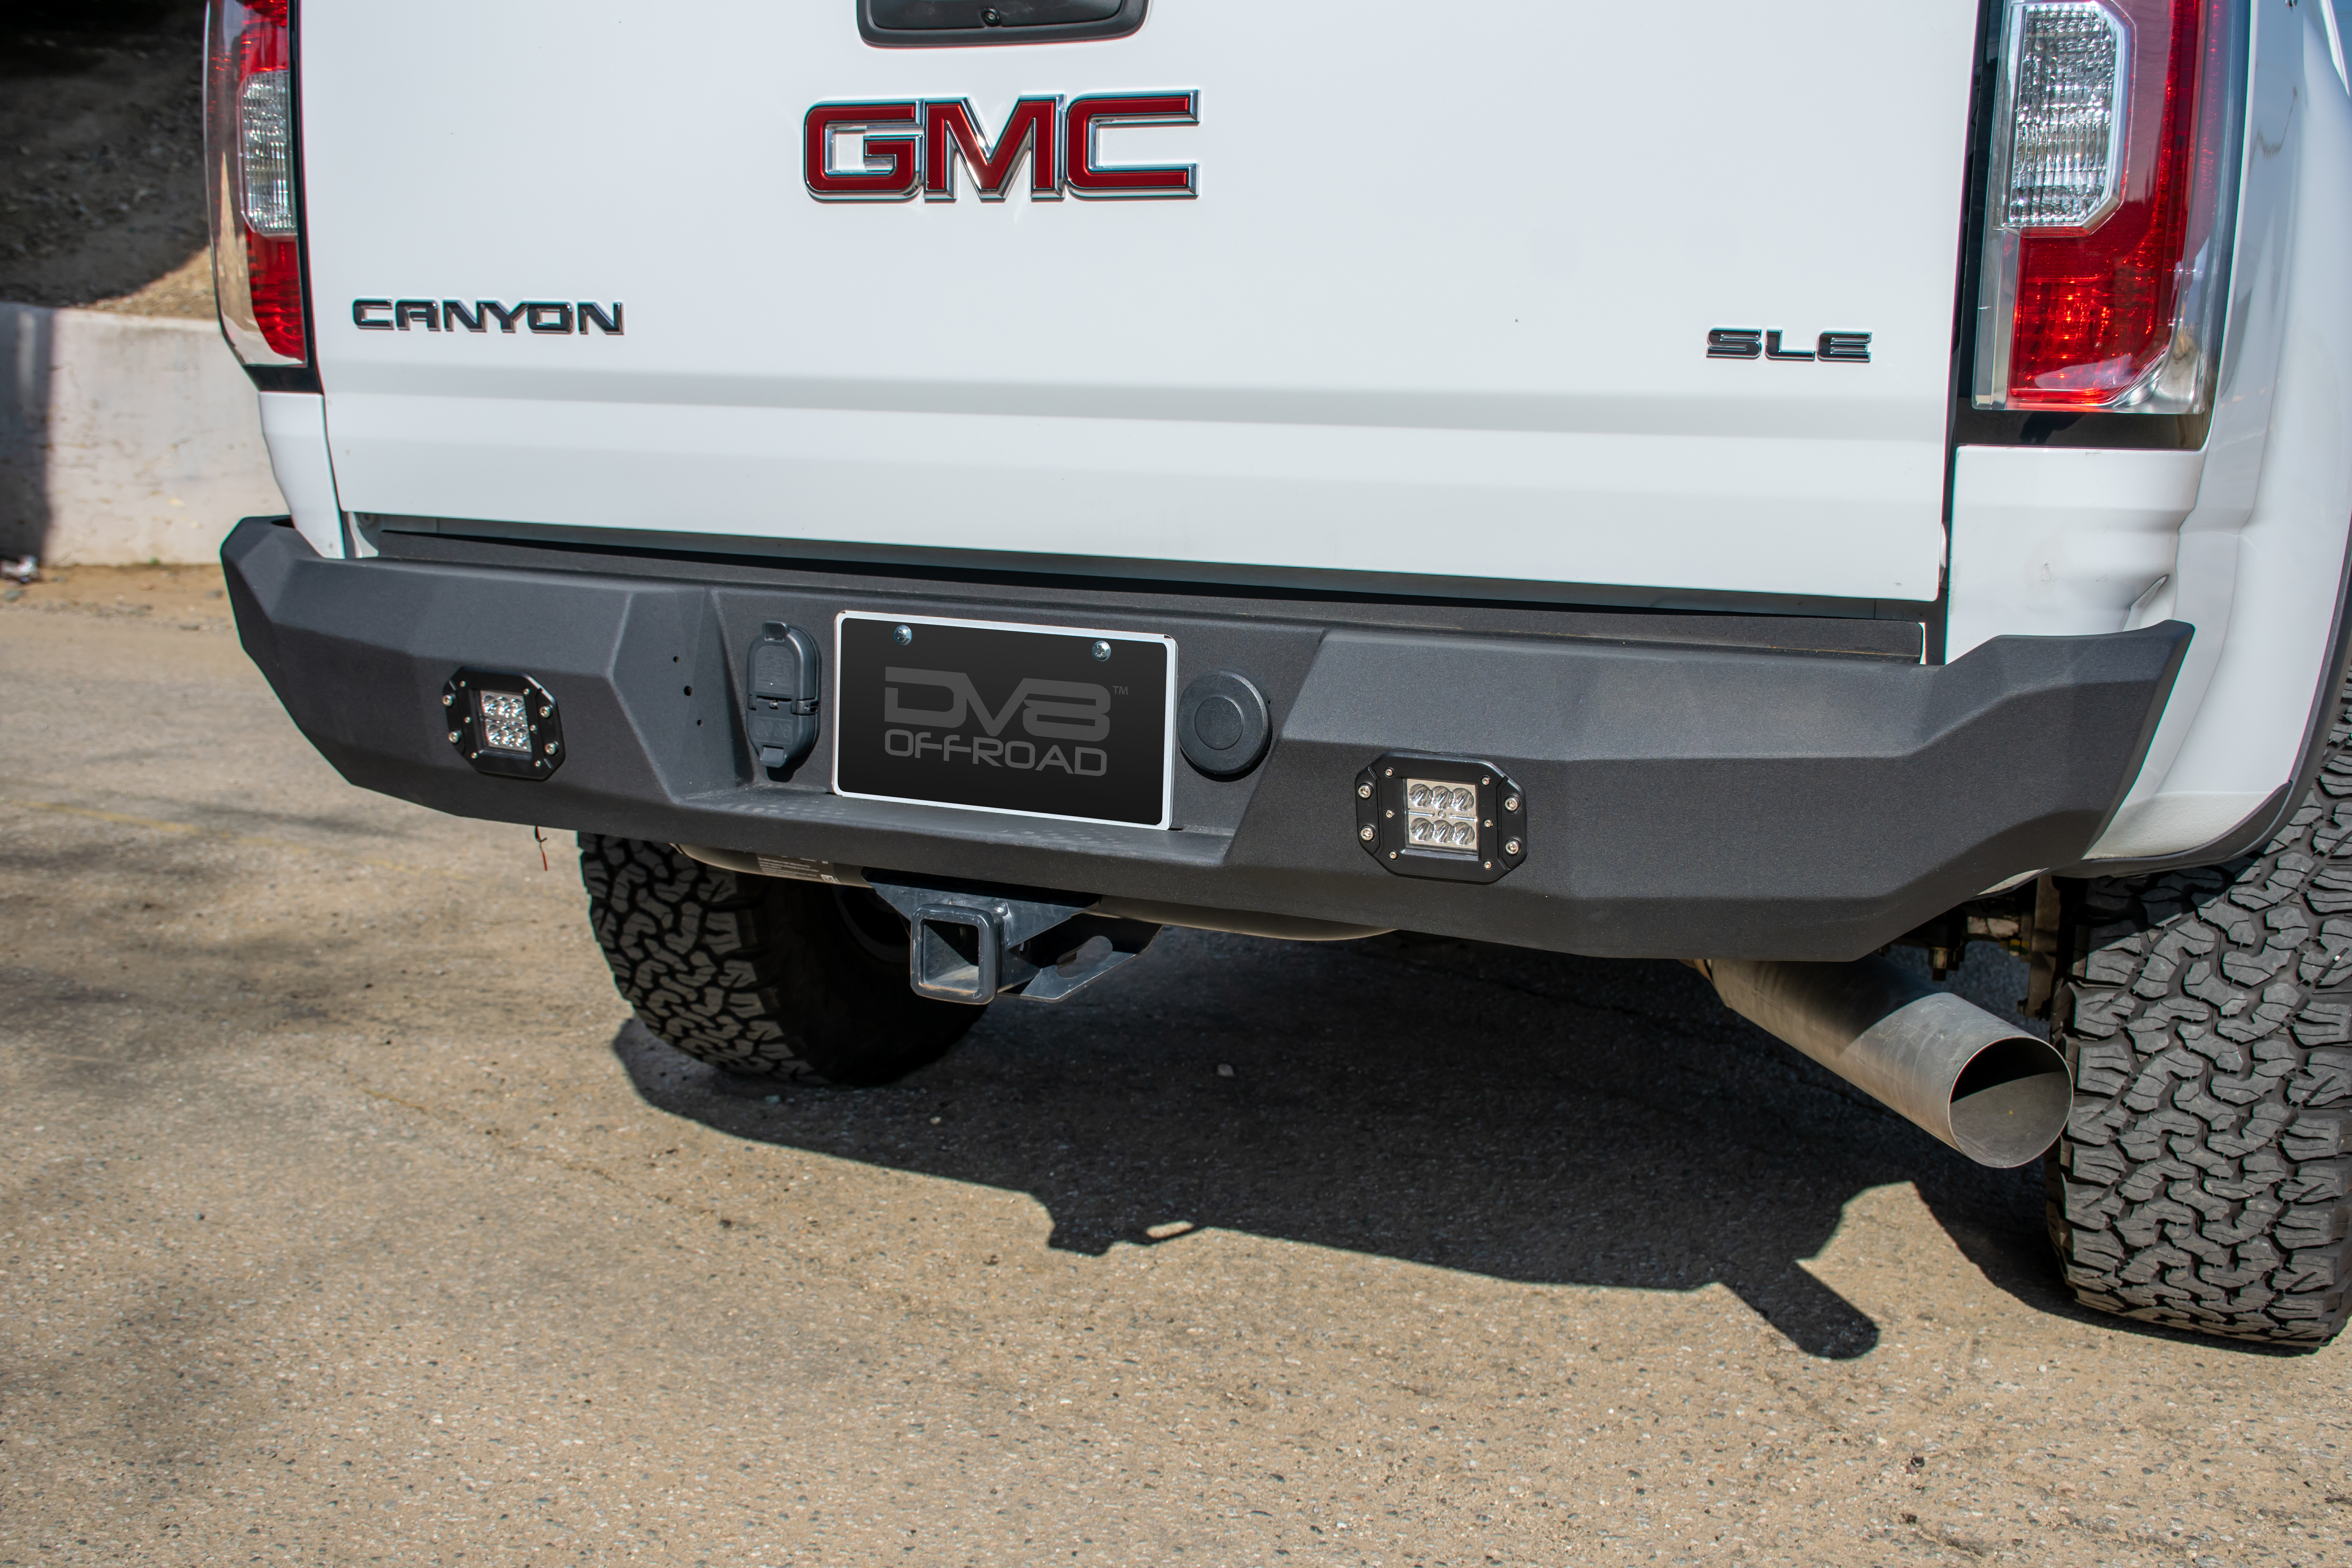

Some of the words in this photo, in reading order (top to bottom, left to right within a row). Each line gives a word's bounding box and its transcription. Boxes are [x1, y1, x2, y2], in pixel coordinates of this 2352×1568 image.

[804, 89, 1200, 203] GMC
[353, 298, 624, 335] CANYON
[1706, 327, 1872, 363] SLE
[884, 666, 1111, 742] DV8
